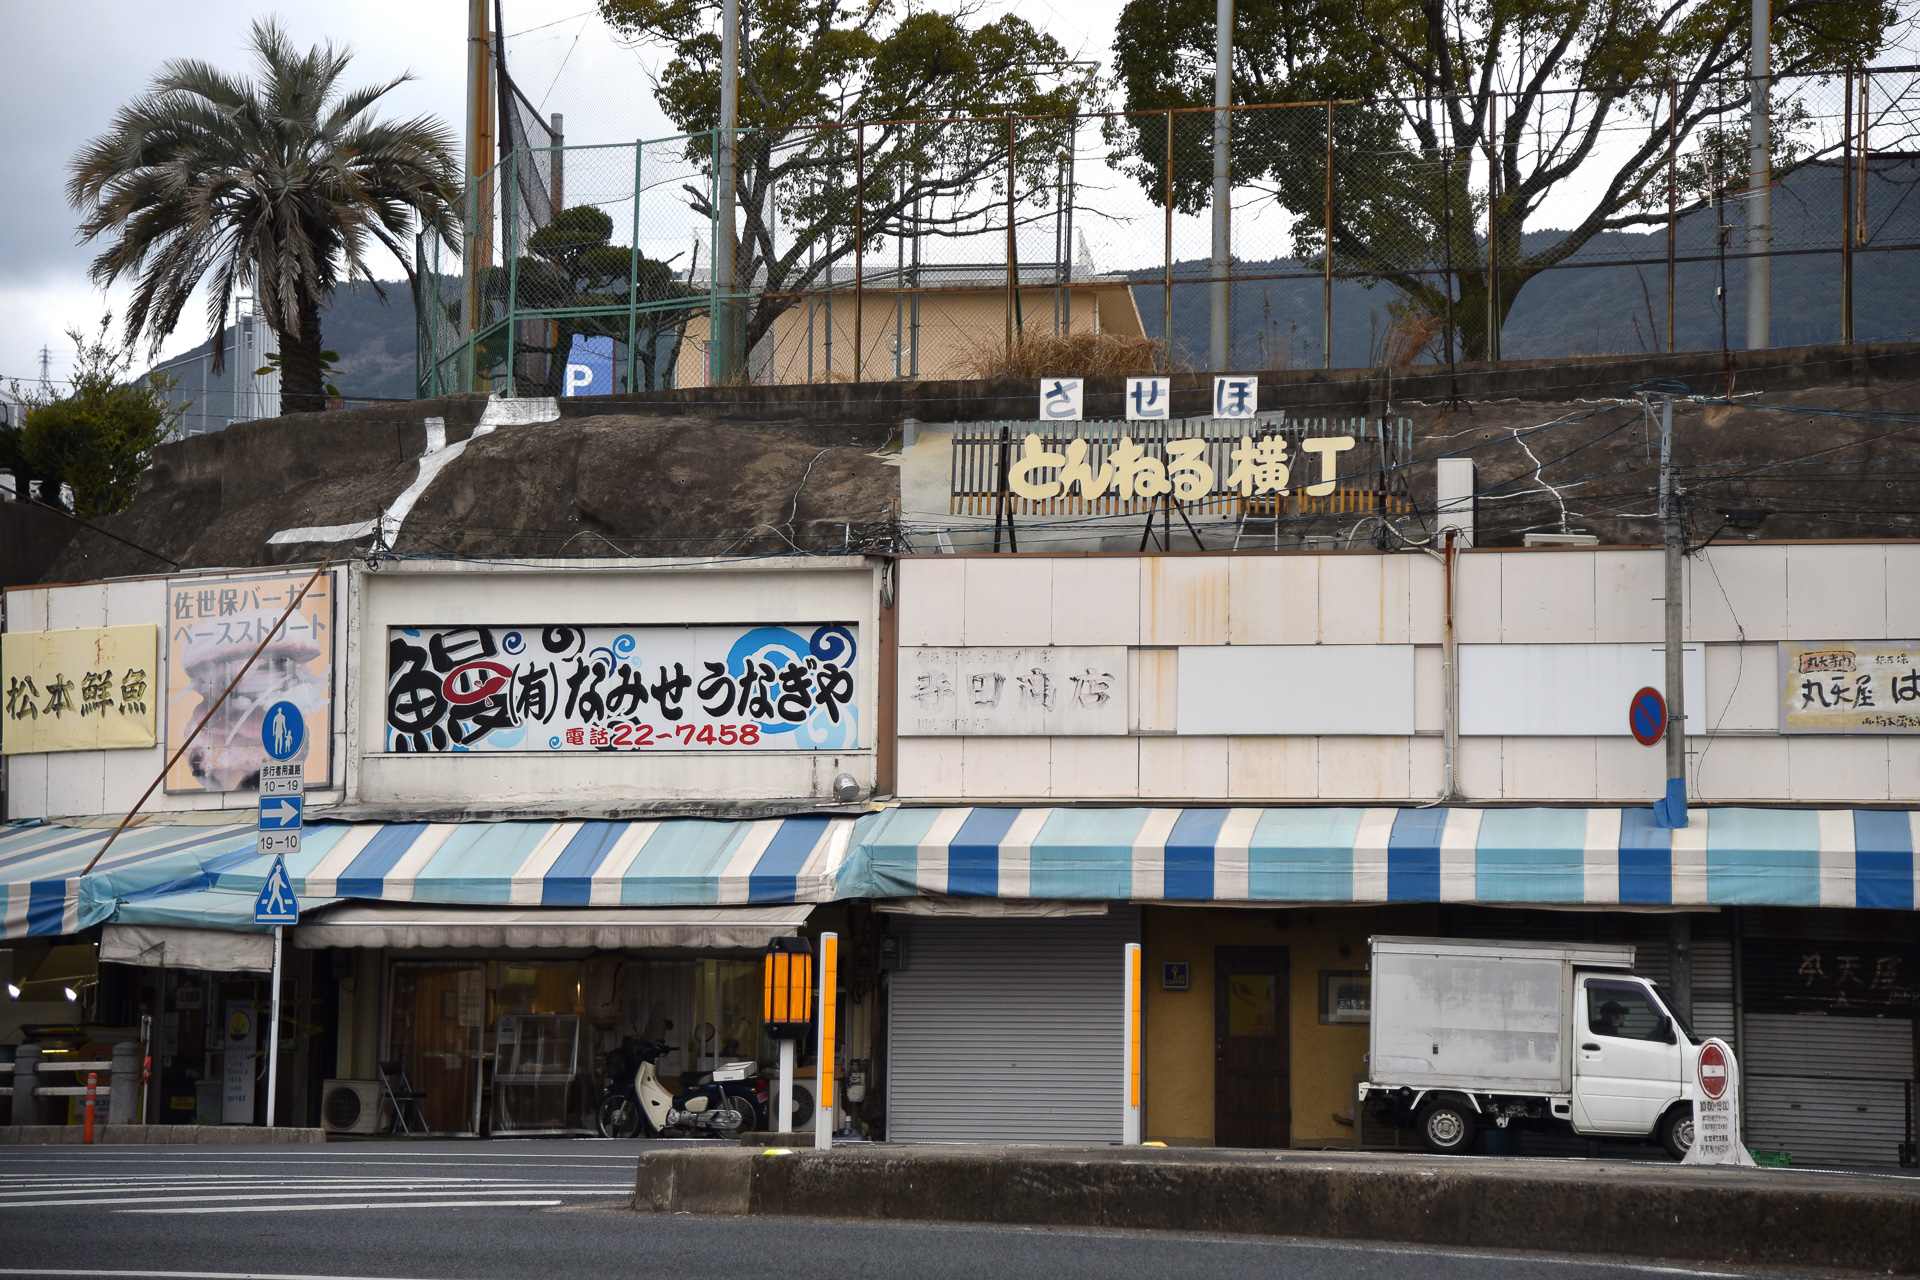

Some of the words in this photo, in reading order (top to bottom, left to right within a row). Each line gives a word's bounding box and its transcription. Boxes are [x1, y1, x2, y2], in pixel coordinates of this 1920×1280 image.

[566, 364, 594, 396] P
[1045, 378, 1257, 418] させぼ
[1008, 434, 1355, 501] とんねる横丁
[174, 583, 326, 620] 佐世保バーガー
[173, 613, 326, 645] ベースストリート
[6, 668, 147, 721] 松本鮮魚
[1801, 674, 1876, 710] 丸天屋
[262, 764, 301, 778] 歩行者用道路
[264, 780, 298, 792] 10-19
[260, 835, 298, 850] 19-10
